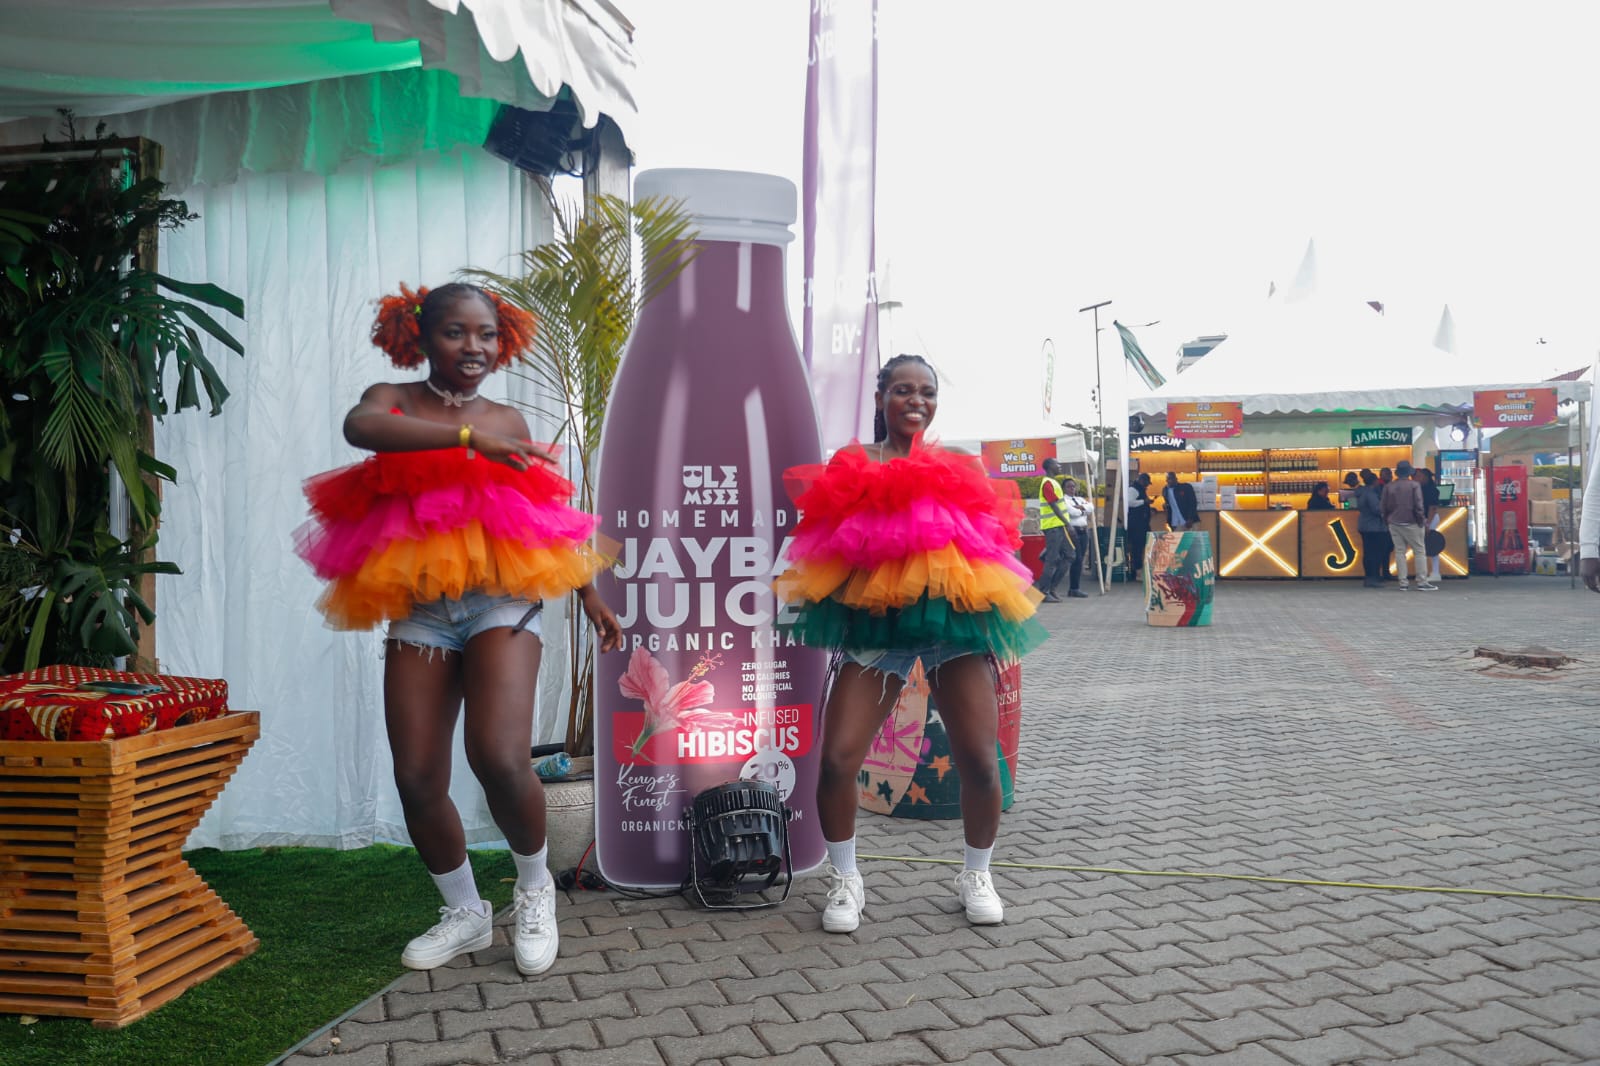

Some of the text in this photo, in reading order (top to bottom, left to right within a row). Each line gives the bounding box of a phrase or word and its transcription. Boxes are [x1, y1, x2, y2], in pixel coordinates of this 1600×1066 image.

[832, 323, 861, 354] BY:
[1498, 413, 1534, 422] Quiver
[1130, 435, 1184, 449] JAMESON
[1354, 430, 1408, 445] JAMESON
[1003, 452, 1034, 462] We Be
[1001, 463, 1036, 473] Burnin
[615, 579, 808, 630] JUICE
[741, 662, 762, 671] ZERO
[741, 671, 791, 682] 120 CALORIES
[742, 682, 793, 693] NO ARTIFICIAL
[743, 708, 799, 727] INFUSED
[678, 726, 800, 758] HIBISCUS
[616, 762, 680, 793] Kenya's
[622, 785, 689, 812] Finest
